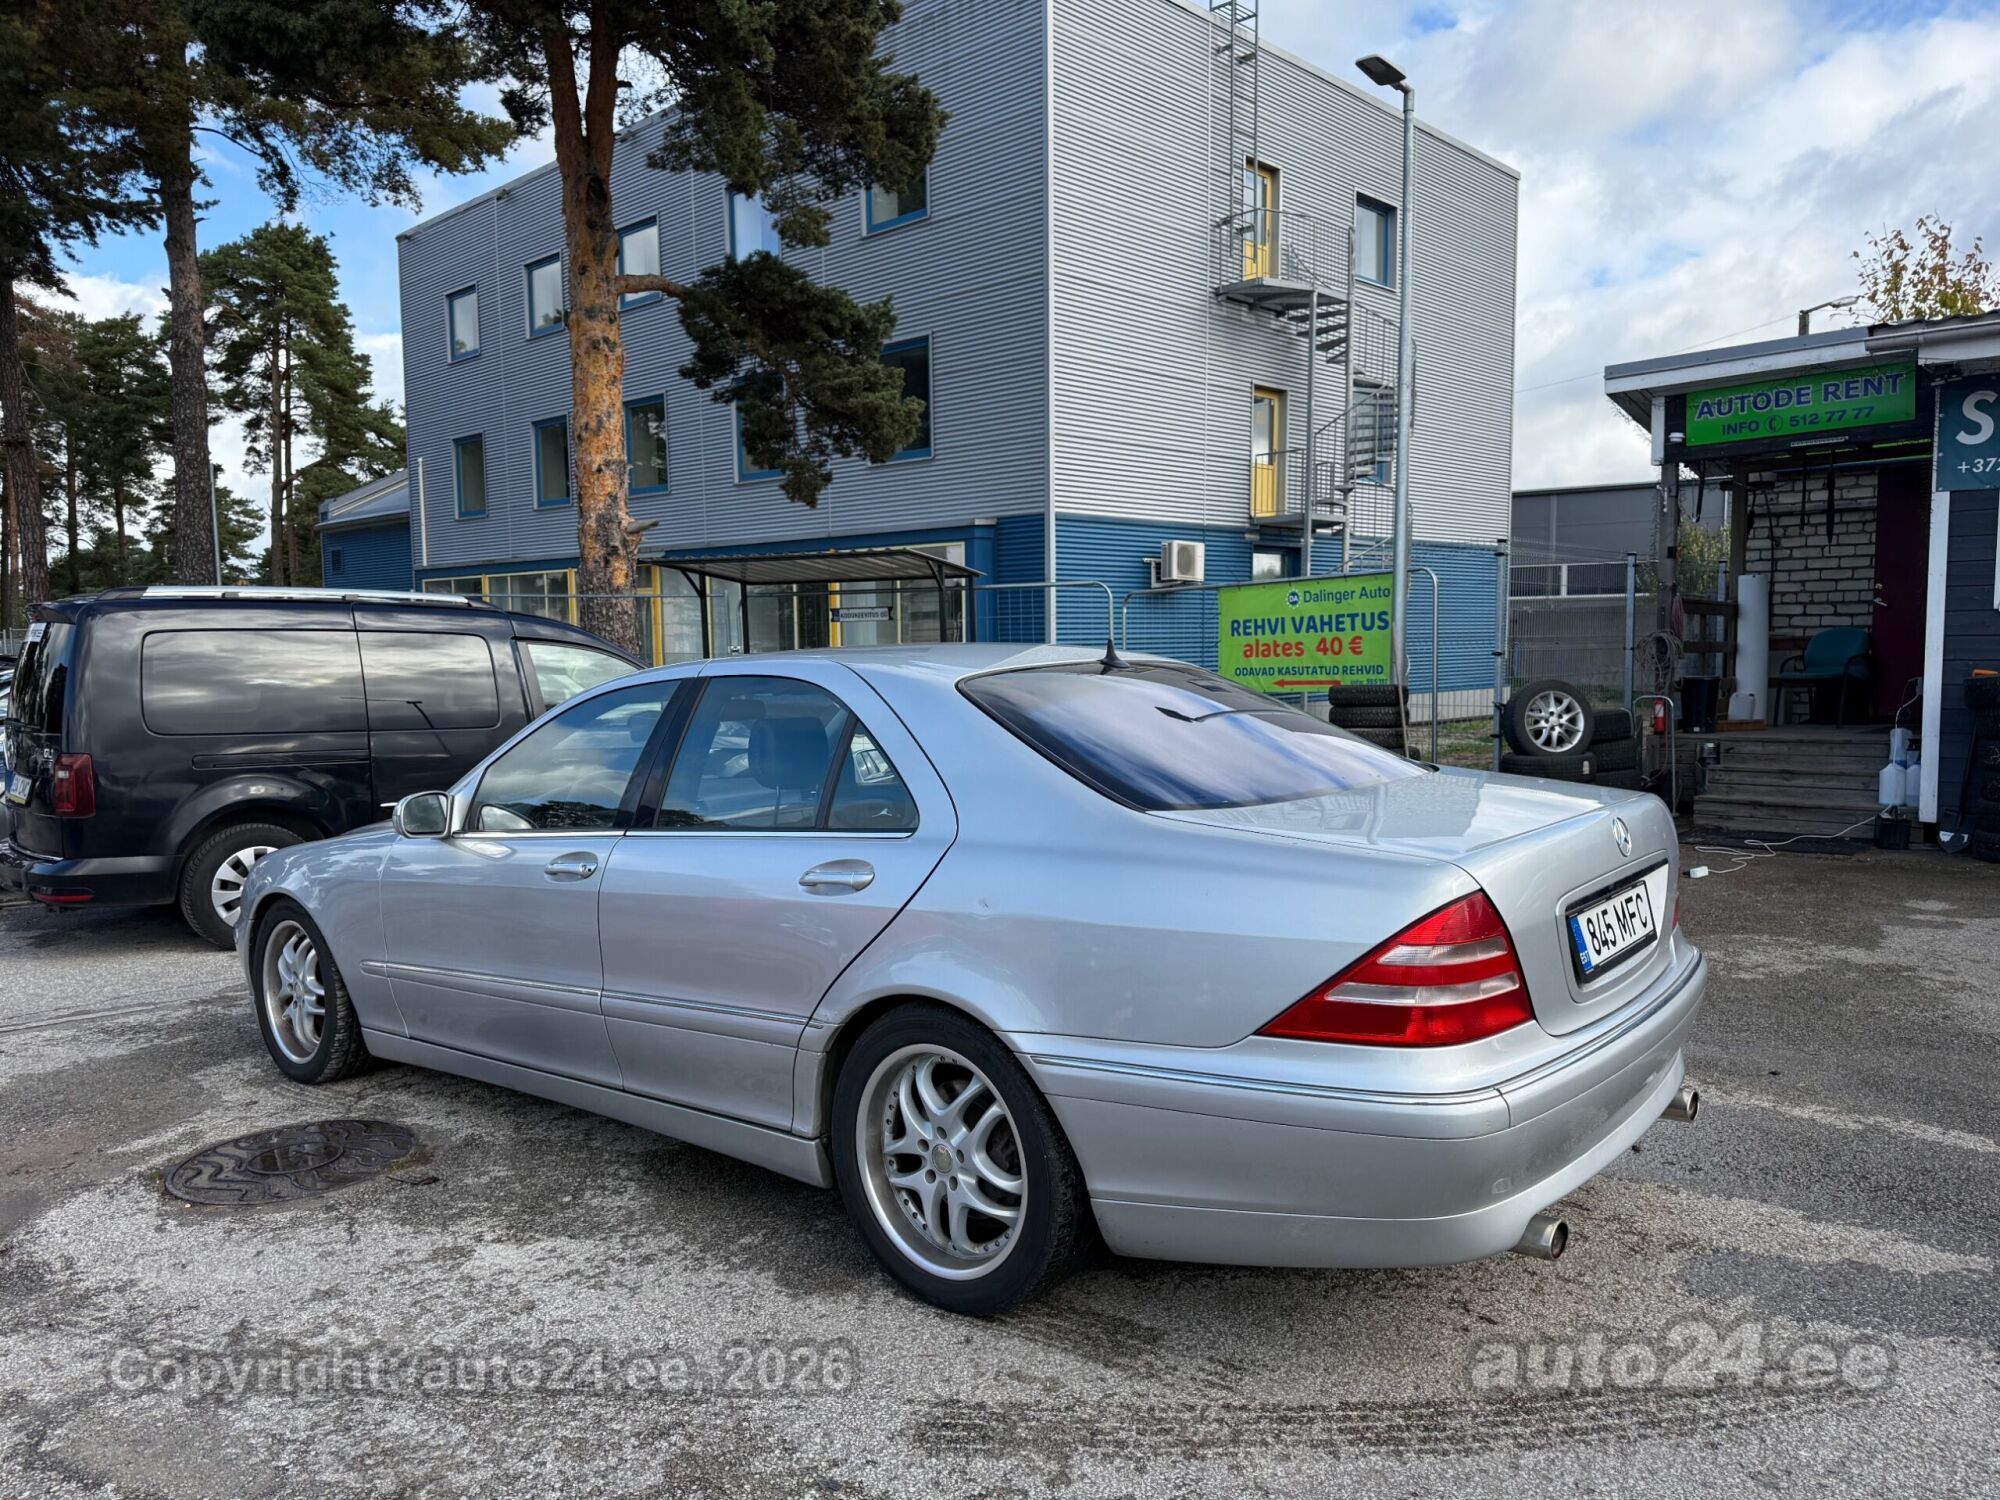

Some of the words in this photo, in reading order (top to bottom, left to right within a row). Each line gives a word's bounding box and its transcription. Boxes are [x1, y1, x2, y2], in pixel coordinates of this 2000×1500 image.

[1695, 384, 1812, 421] AUTODE
[1822, 372, 1904, 403] RENT
[1722, 420, 1760, 437] INFO
[1789, 412, 1820, 429] 512
[1825, 409, 1847, 424] 77
[1852, 405, 1875, 421] 77
[1303, 588, 1355, 606] Dalinger
[1359, 585, 1391, 599] Auto
[1230, 616, 1286, 638] REHVI
[1291, 610, 1390, 635] VAHETUS
[1242, 638, 1306, 659] alates
[1314, 636, 1343, 657] 40
[1348, 635, 1364, 656] €
[1234, 666, 1276, 678] ODAVAD
[1277, 664, 1340, 677] KASUTATUD
[1341, 664, 1384, 676] REHVID
[1586, 908, 1617, 957] 845
[1612, 892, 1649, 942] MFC
[1579, 949, 1591, 965] EST
